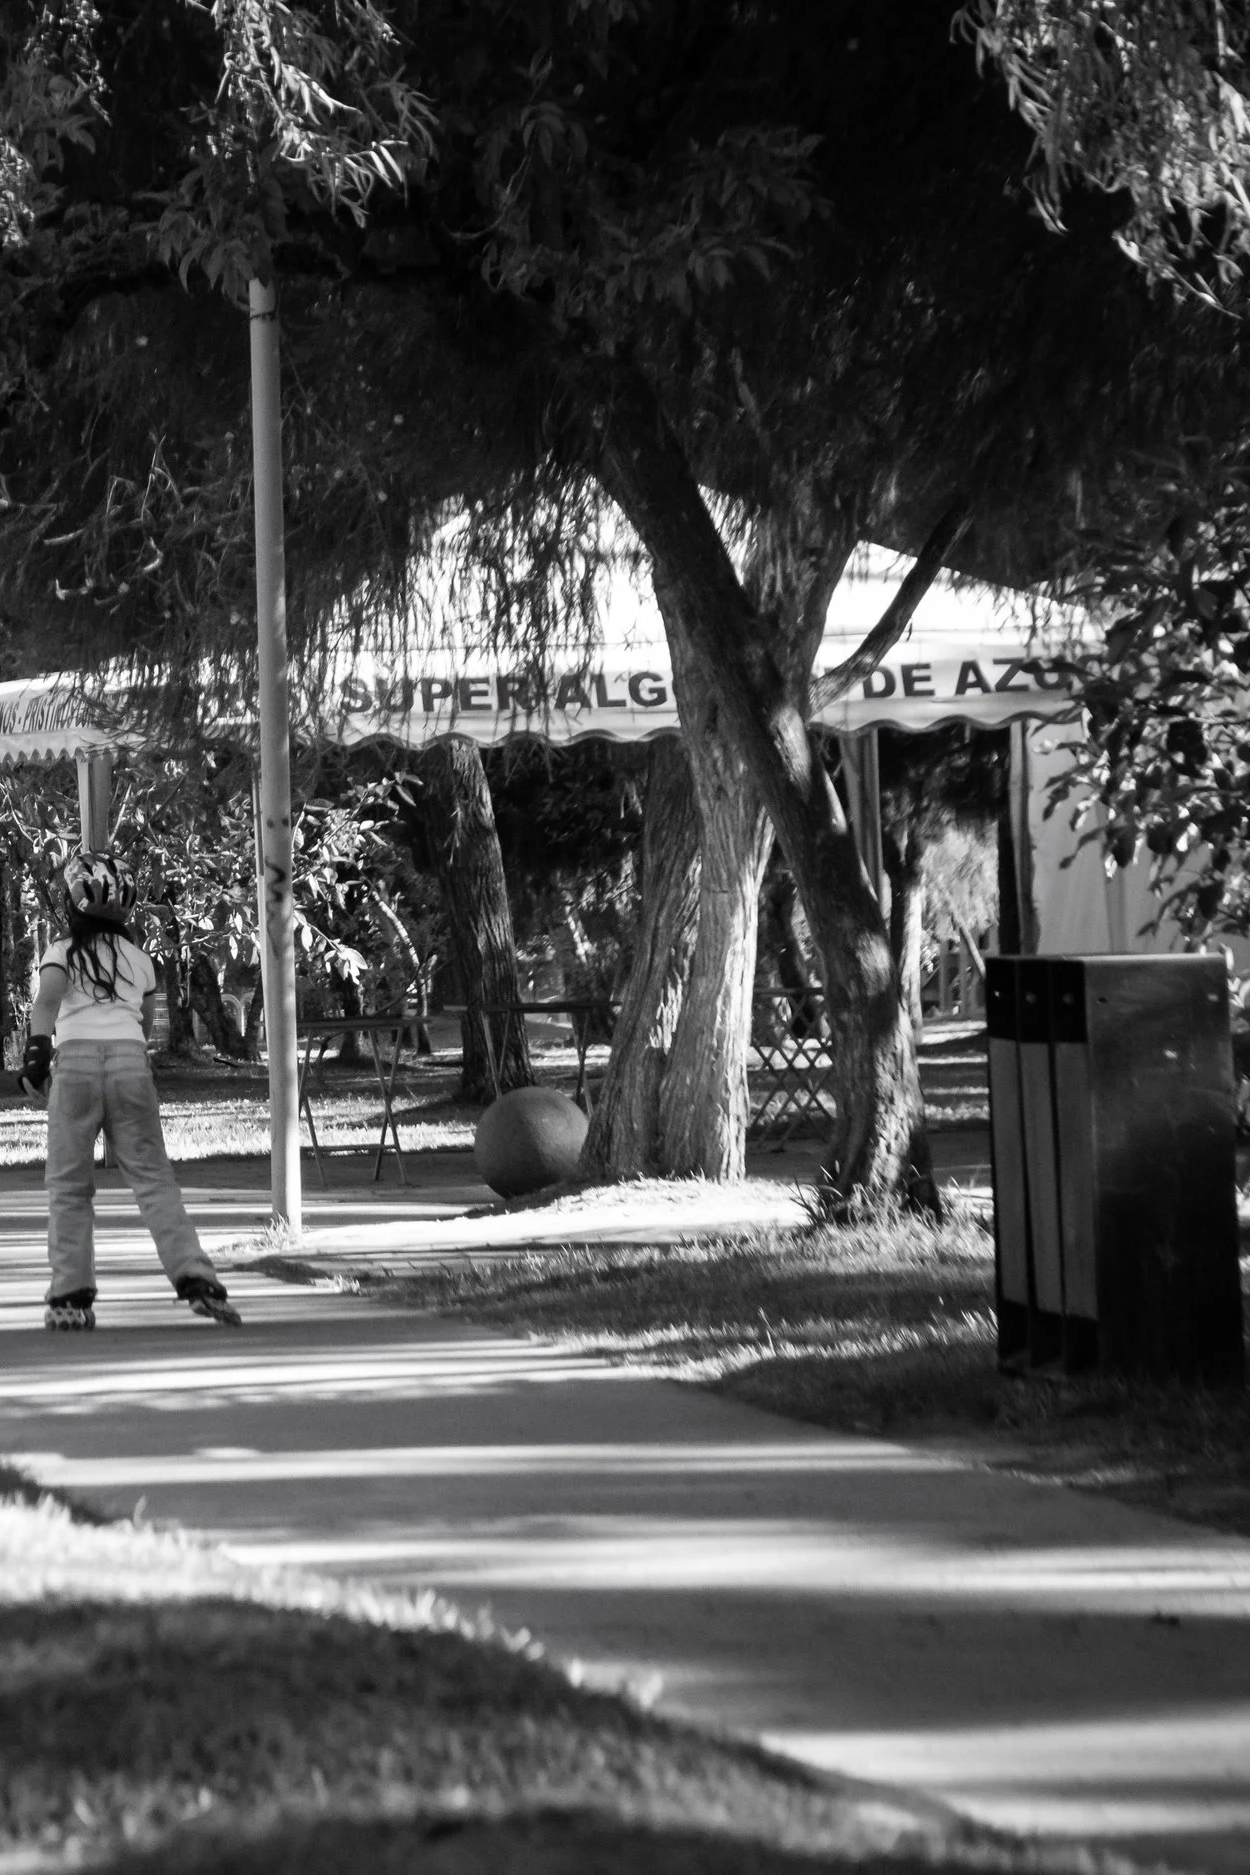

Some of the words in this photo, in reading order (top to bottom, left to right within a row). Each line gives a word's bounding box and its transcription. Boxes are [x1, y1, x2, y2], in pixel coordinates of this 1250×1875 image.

[339, 675, 533, 713] SUPER
[554, 671, 668, 709] ALG
[862, 662, 935, 698] DE
